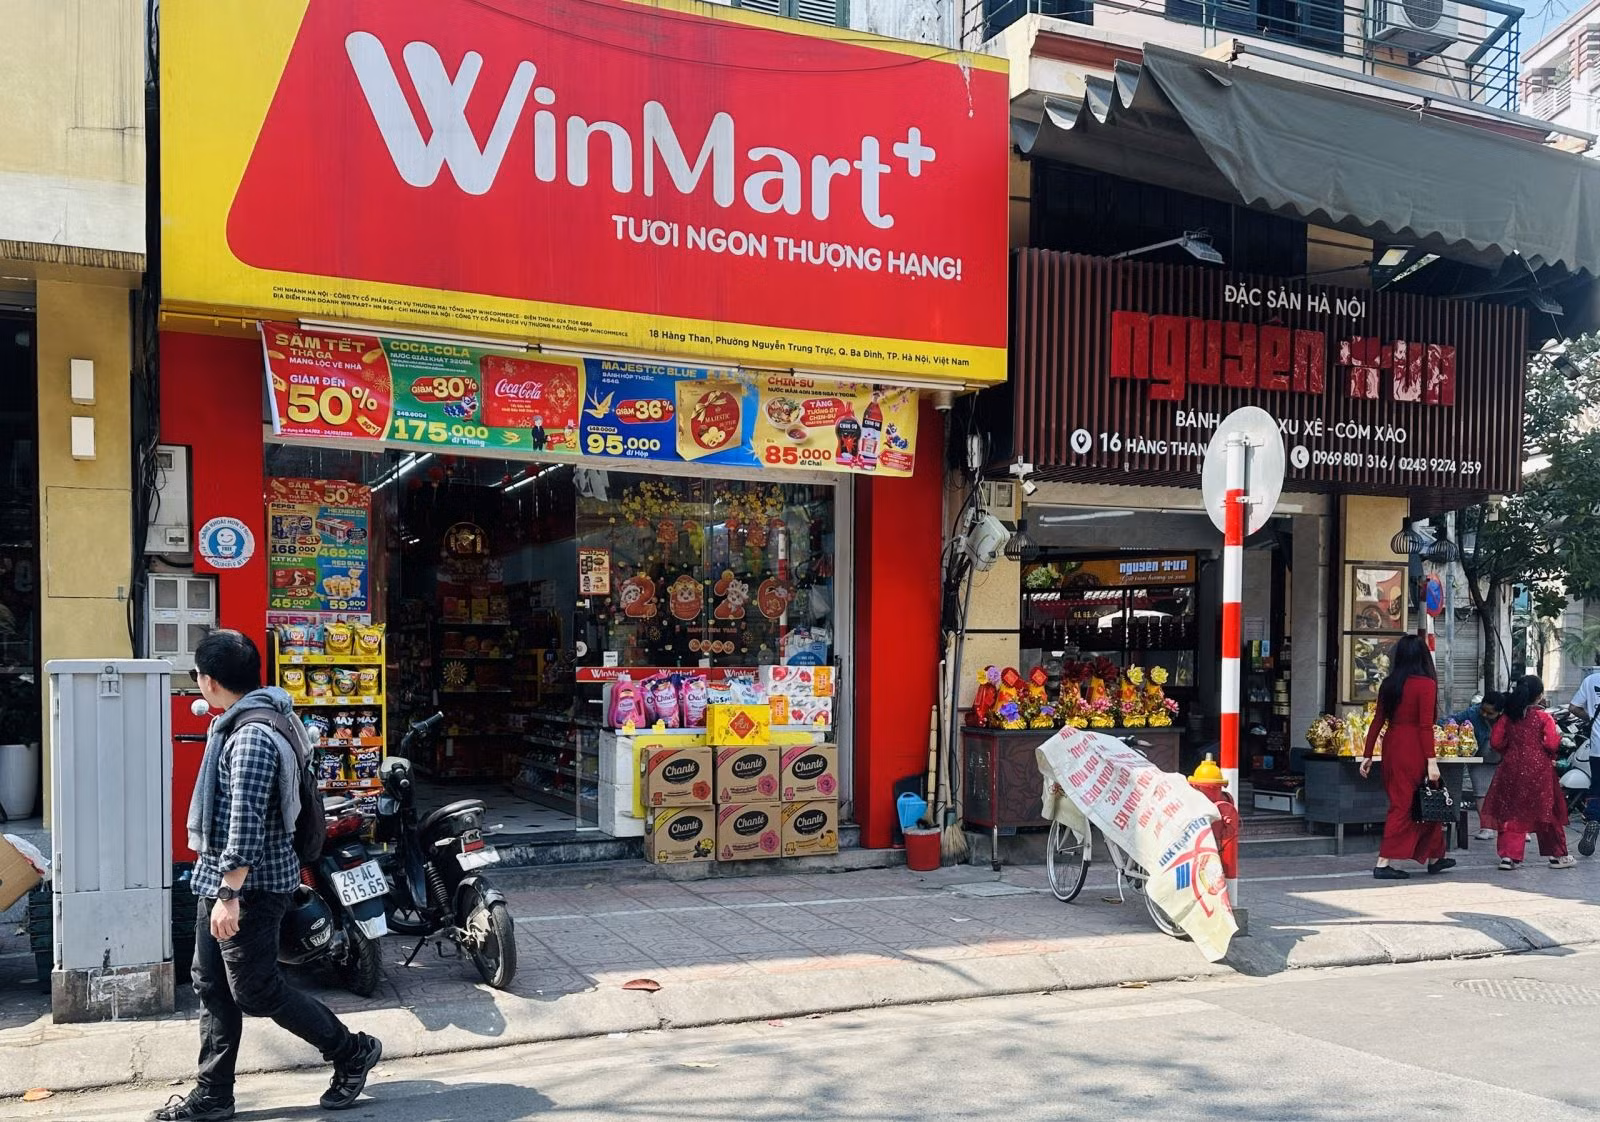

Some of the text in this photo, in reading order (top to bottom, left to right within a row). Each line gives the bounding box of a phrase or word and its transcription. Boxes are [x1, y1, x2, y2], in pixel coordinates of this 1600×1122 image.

[346, 31, 936, 229] WinMart+
[612, 215, 962, 281] TƯƠI NGON THƯỢNG HẠNG!
[317, 297, 339, 305] DOANH
[1224, 282, 1366, 323] ĐẶC SẢN HÀ NỘI
[316, 351, 333, 360] GA
[390, 341, 470, 358] COCA-COLA
[649, 330, 970, 366] 18 Hàng Than, Phường Nguyễn Trung Trực, Q. Ba Đình, TP. Hà Nội, Việt Nam
[289, 357, 314, 365] MANG
[315, 360, 331, 368] LỘC
[344, 362, 362, 370] NHÀ
[601, 360, 697, 378] MAJESTIC BLUE
[290, 374, 346, 387] GIẢM ĐẾN
[433, 377, 477, 398] 30%
[767, 376, 814, 388] CHIN-SU
[287, 383, 378, 425] 50%
[635, 400, 674, 420] 36%
[394, 418, 489, 442] 175.000
[1175, 408, 1407, 443] BÁNH XU XÊ XÀO
[587, 433, 661, 455] 95.000
[1100, 432, 1208, 456] 16 HÀNG THAN
[765, 445, 832, 465] 85.000
[1312, 450, 1482, 475] 0969 801 0243 9274 259
[665, 764, 696, 777] Chanté
[734, 758, 763, 772] Chanté
[794, 758, 824, 772] Chanté
[671, 820, 700, 834] Chanté
[736, 815, 765, 829] Chanté
[796, 815, 824, 829] Chanté
[340, 865, 375, 887] 29-AC
[341, 878, 385, 903] 615.65
